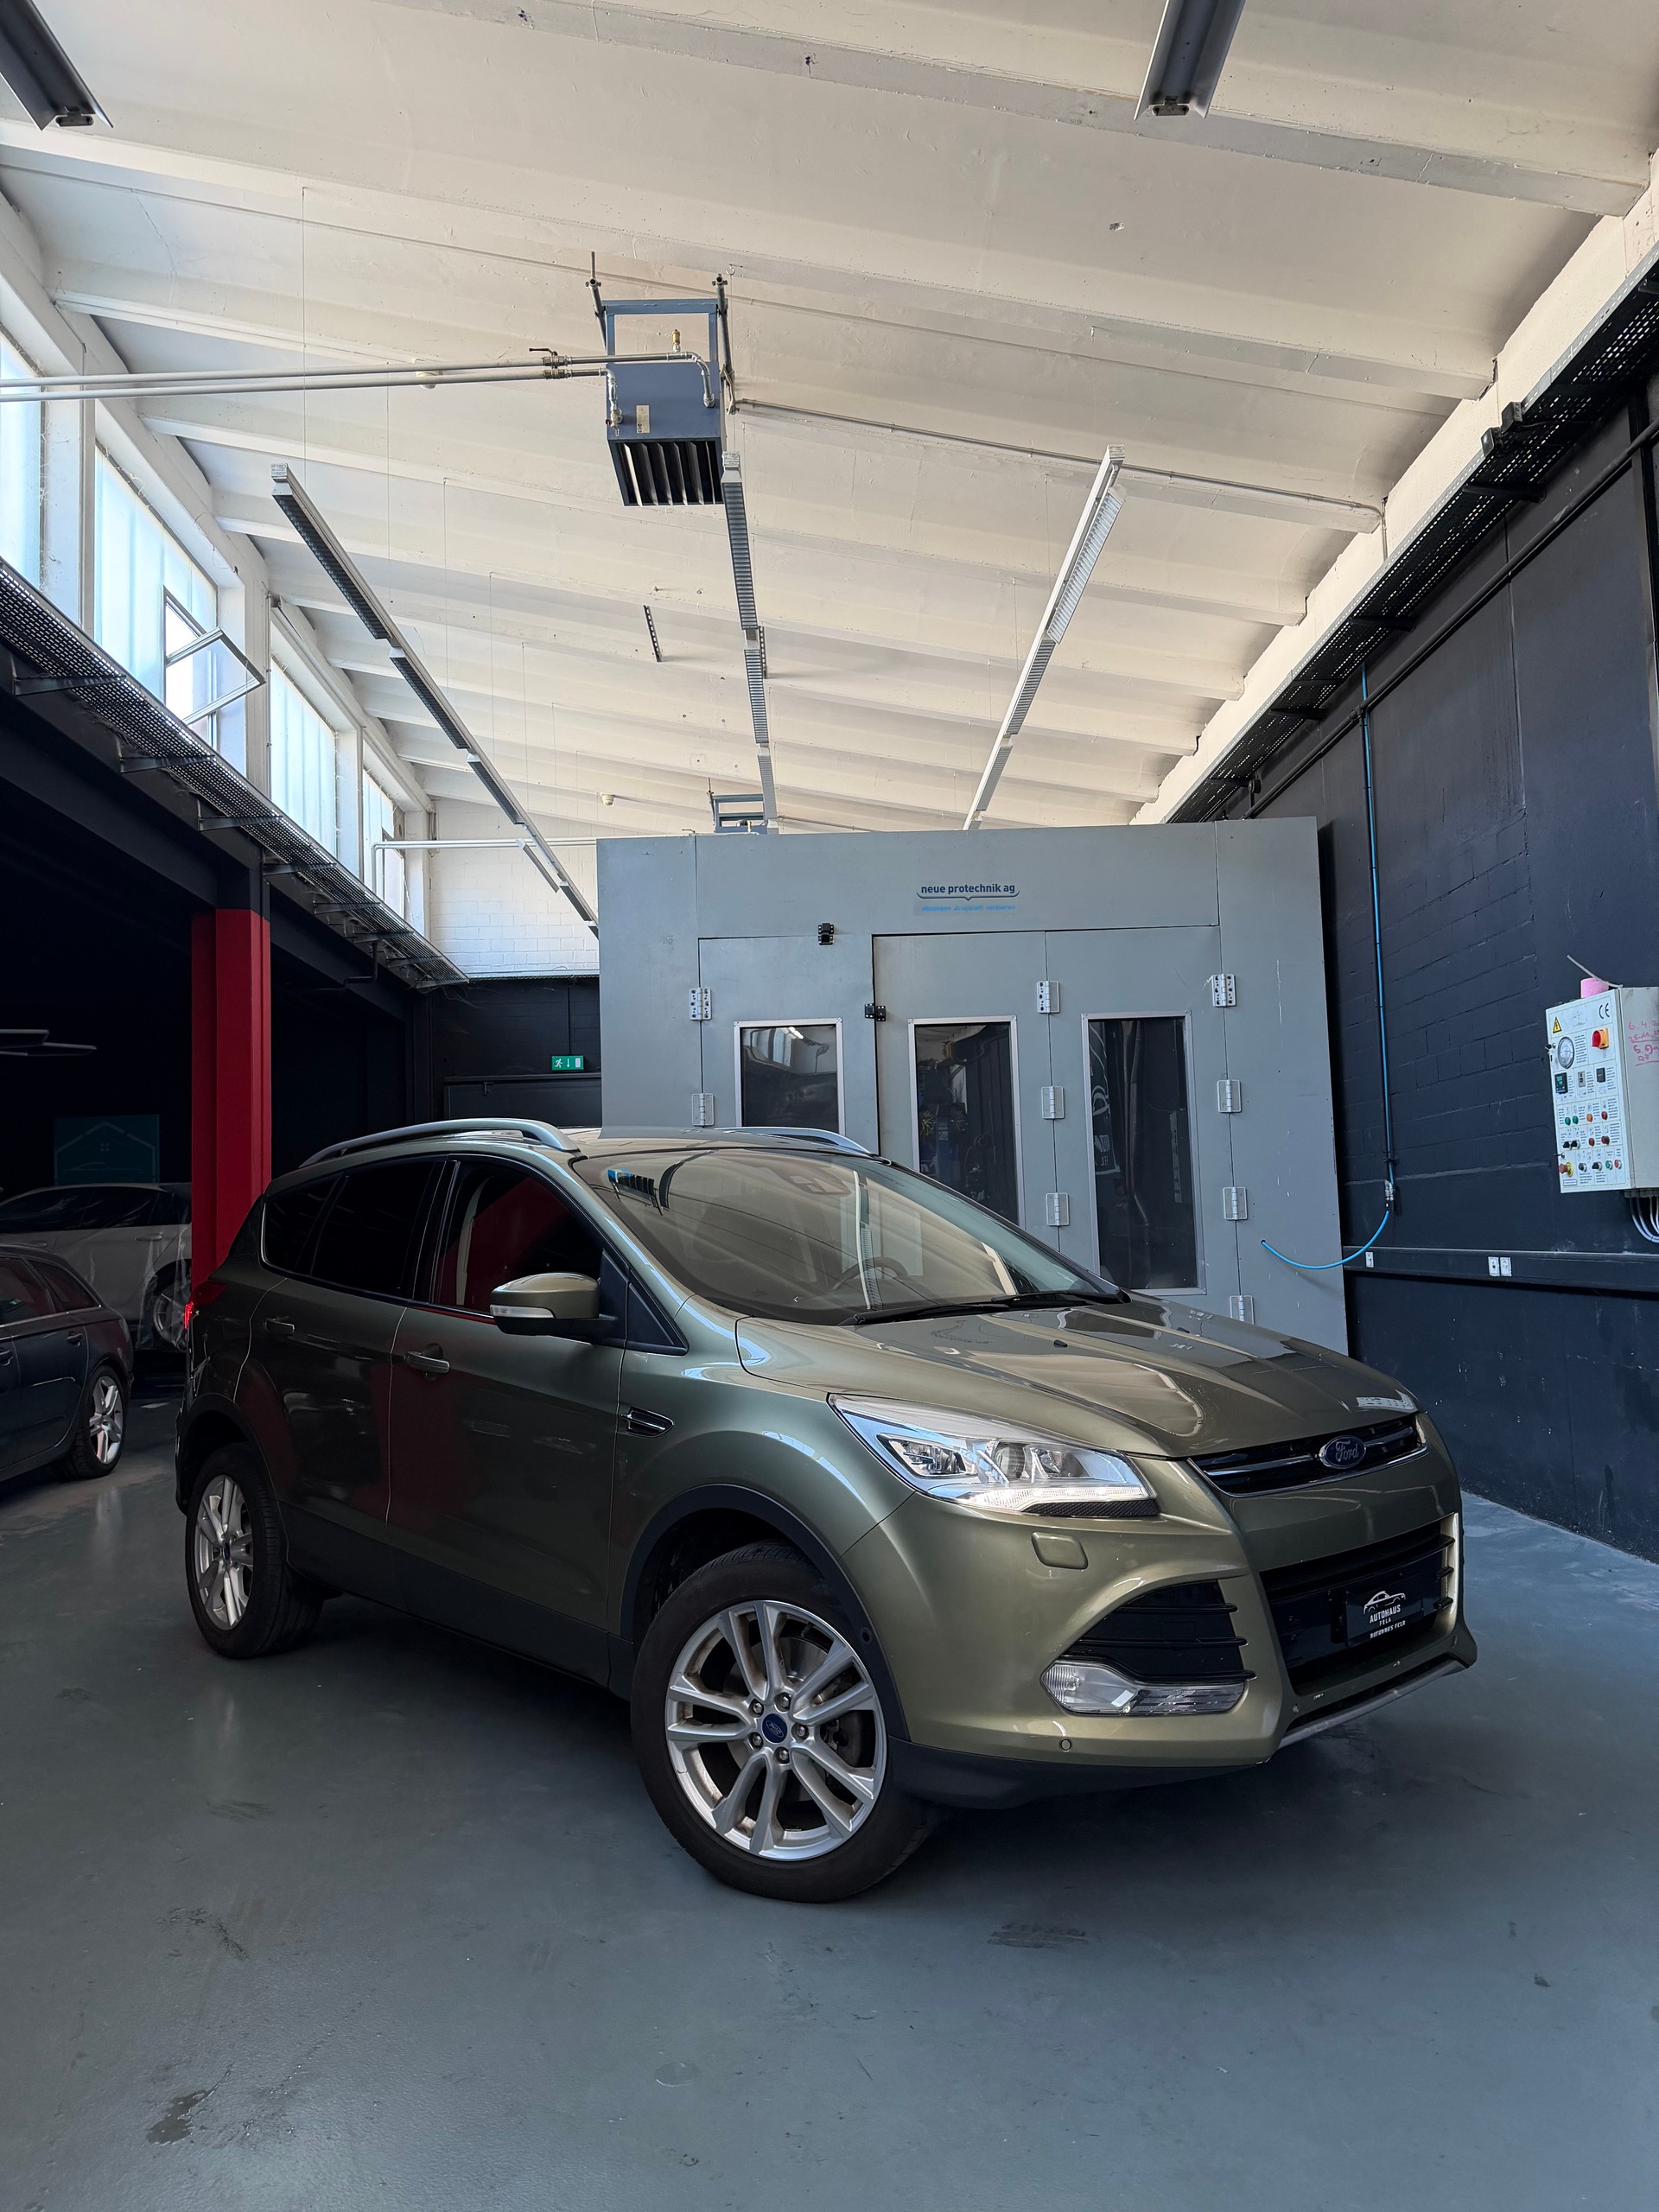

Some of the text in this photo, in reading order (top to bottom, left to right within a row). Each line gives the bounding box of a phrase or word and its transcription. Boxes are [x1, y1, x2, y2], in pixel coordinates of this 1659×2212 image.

[948, 884, 1001, 894] protechnik
[1003, 885, 1015, 893] ag
[1335, 1440, 1359, 1462] Ford
[1370, 1604, 1401, 1624] AUTOHAUS
